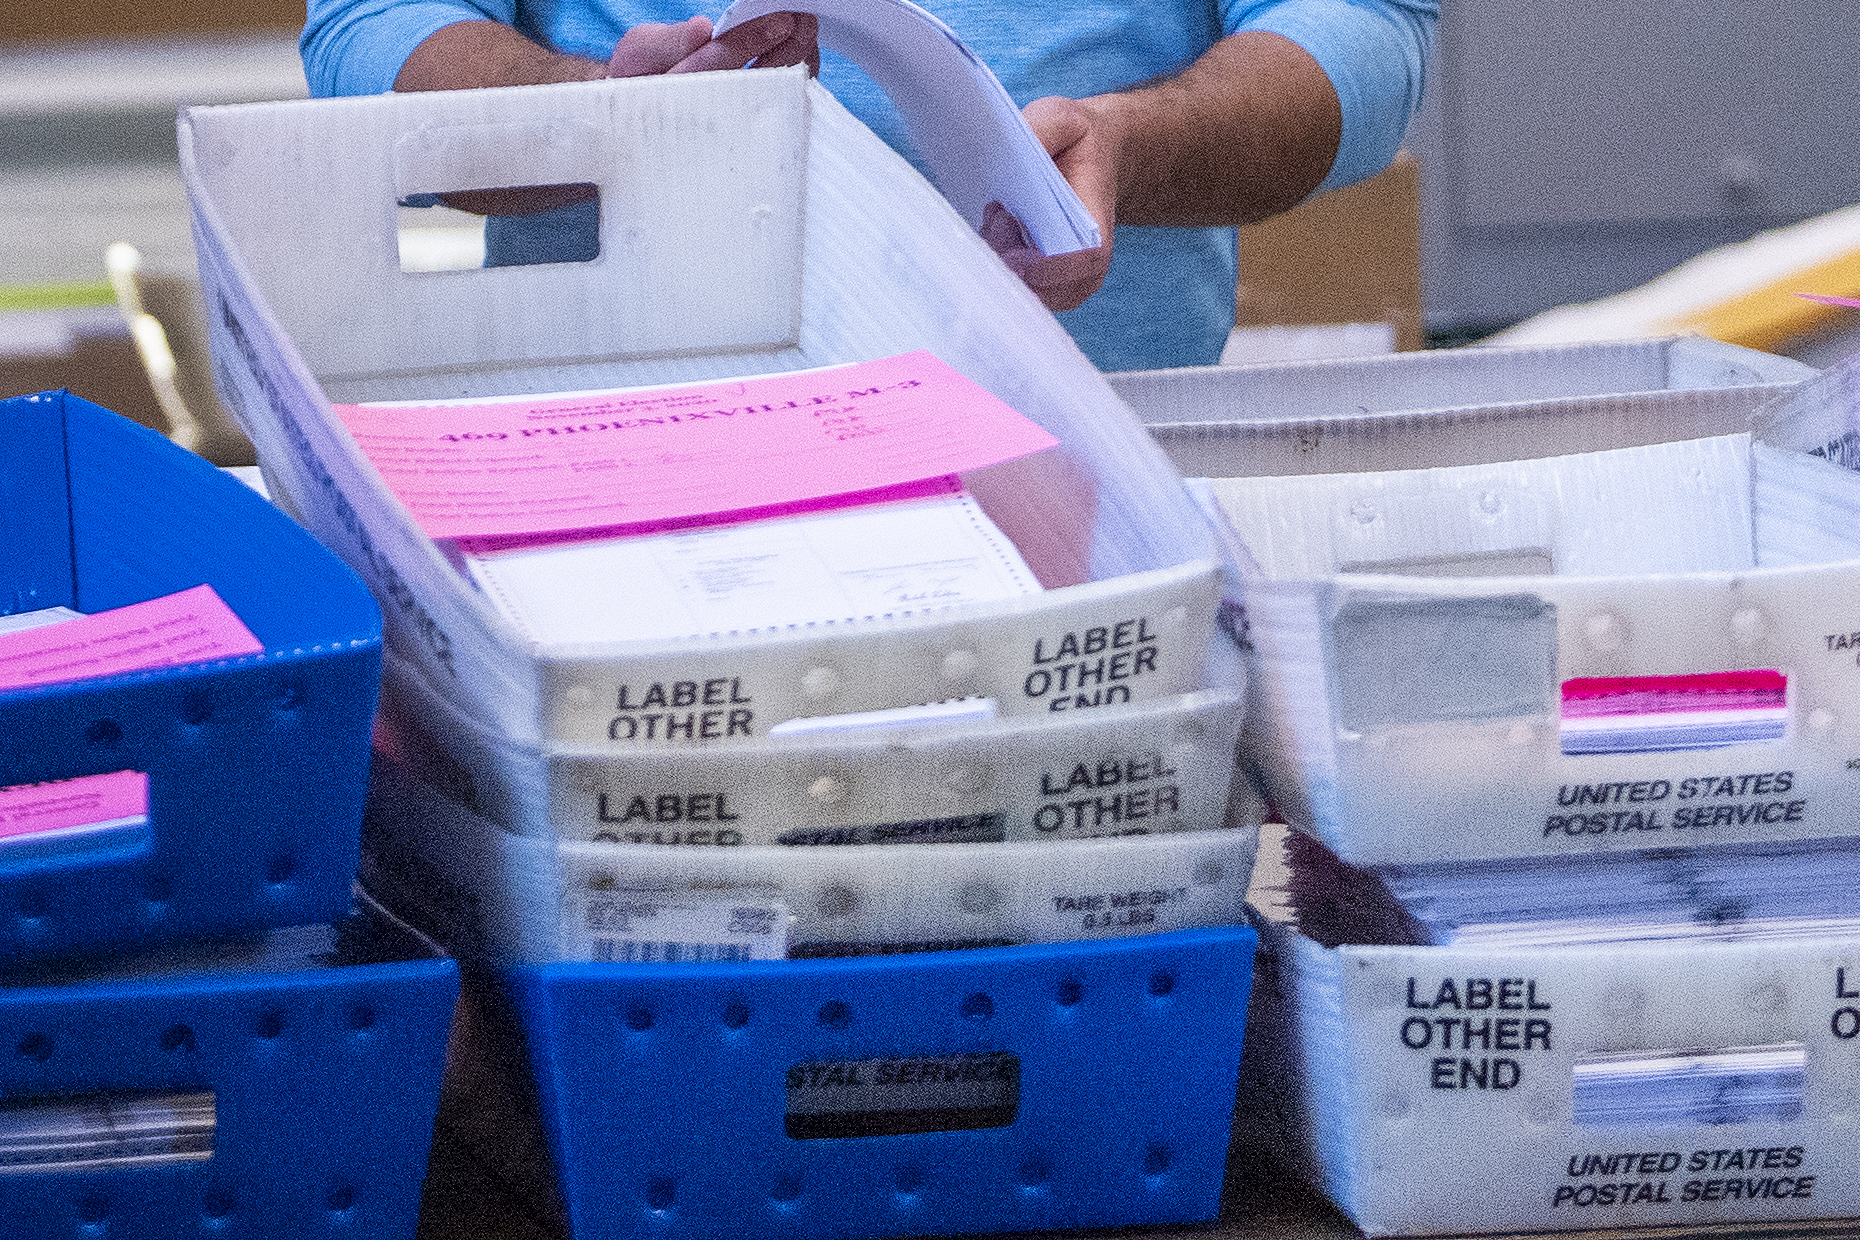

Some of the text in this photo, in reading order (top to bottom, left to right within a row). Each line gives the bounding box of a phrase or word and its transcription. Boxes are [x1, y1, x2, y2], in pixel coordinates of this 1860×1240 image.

[1033, 617, 1157, 665] LABEL
[1024, 644, 1158, 697] OTHER
[616, 677, 753, 711] LABEL
[607, 709, 754, 740] OTHER
[1041, 753, 1178, 796] LABEL
[1557, 770, 1794, 807] UNITED STATES
[598, 792, 740, 824] LABEL
[1032, 784, 1179, 832] OTHER
[1543, 798, 1807, 838] POSTAL SERVICE
[1405, 976, 1552, 1010] LABEL
[1401, 1016, 1552, 1050] OTHER
[1431, 1057, 1521, 1090] END
[1567, 1145, 1804, 1178] UNITED STATES
[1552, 1174, 1816, 1208] POSTAL SERVICE
